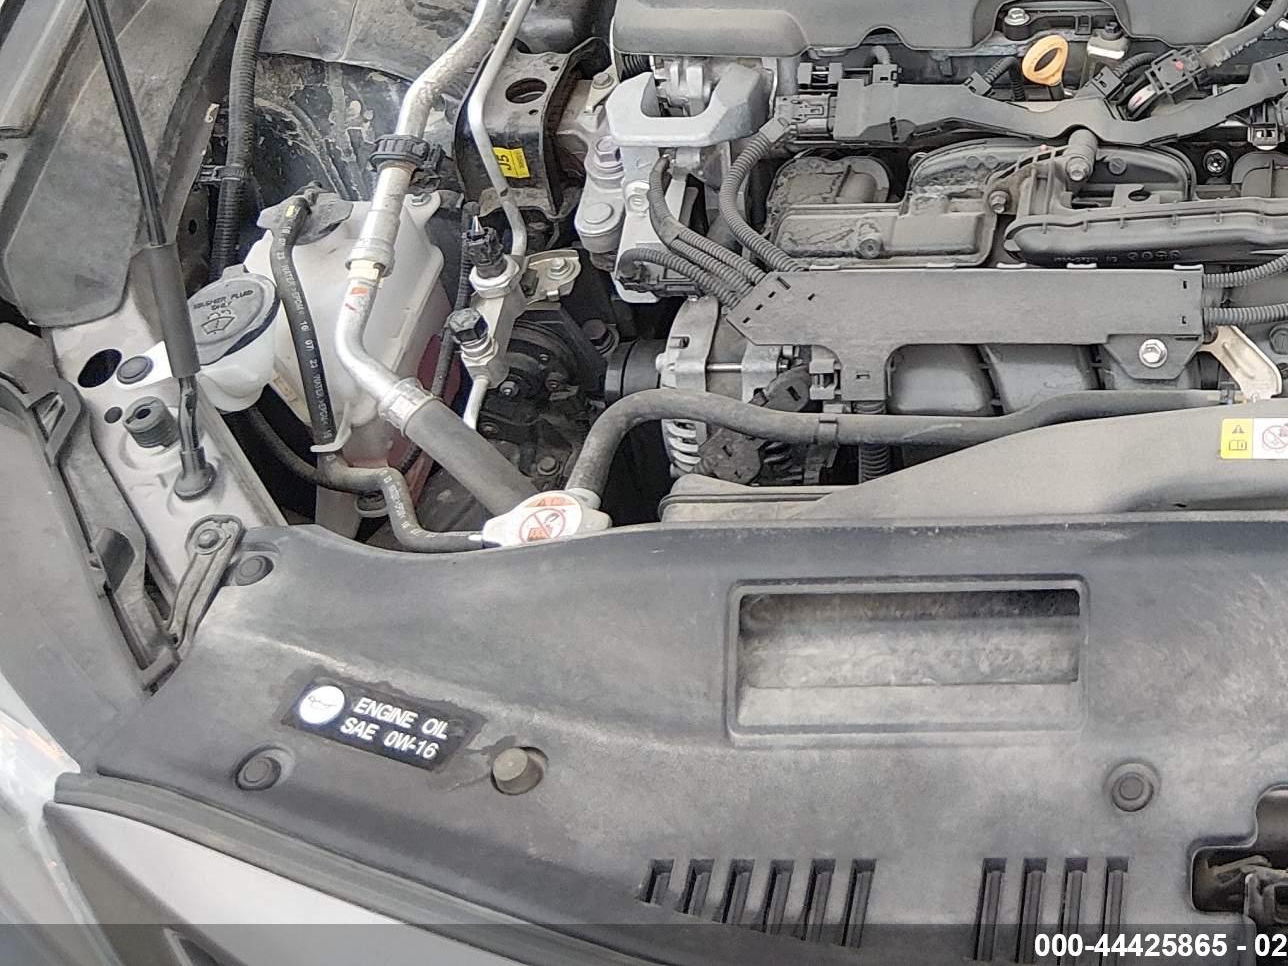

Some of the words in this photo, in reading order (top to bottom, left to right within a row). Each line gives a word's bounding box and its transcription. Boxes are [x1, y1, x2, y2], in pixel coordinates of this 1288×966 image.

[340, 717, 380, 741] SAE
[383, 731, 440, 760] 0W-16
[353, 697, 418, 729] ENGINE
[422, 718, 449, 740] OIL
